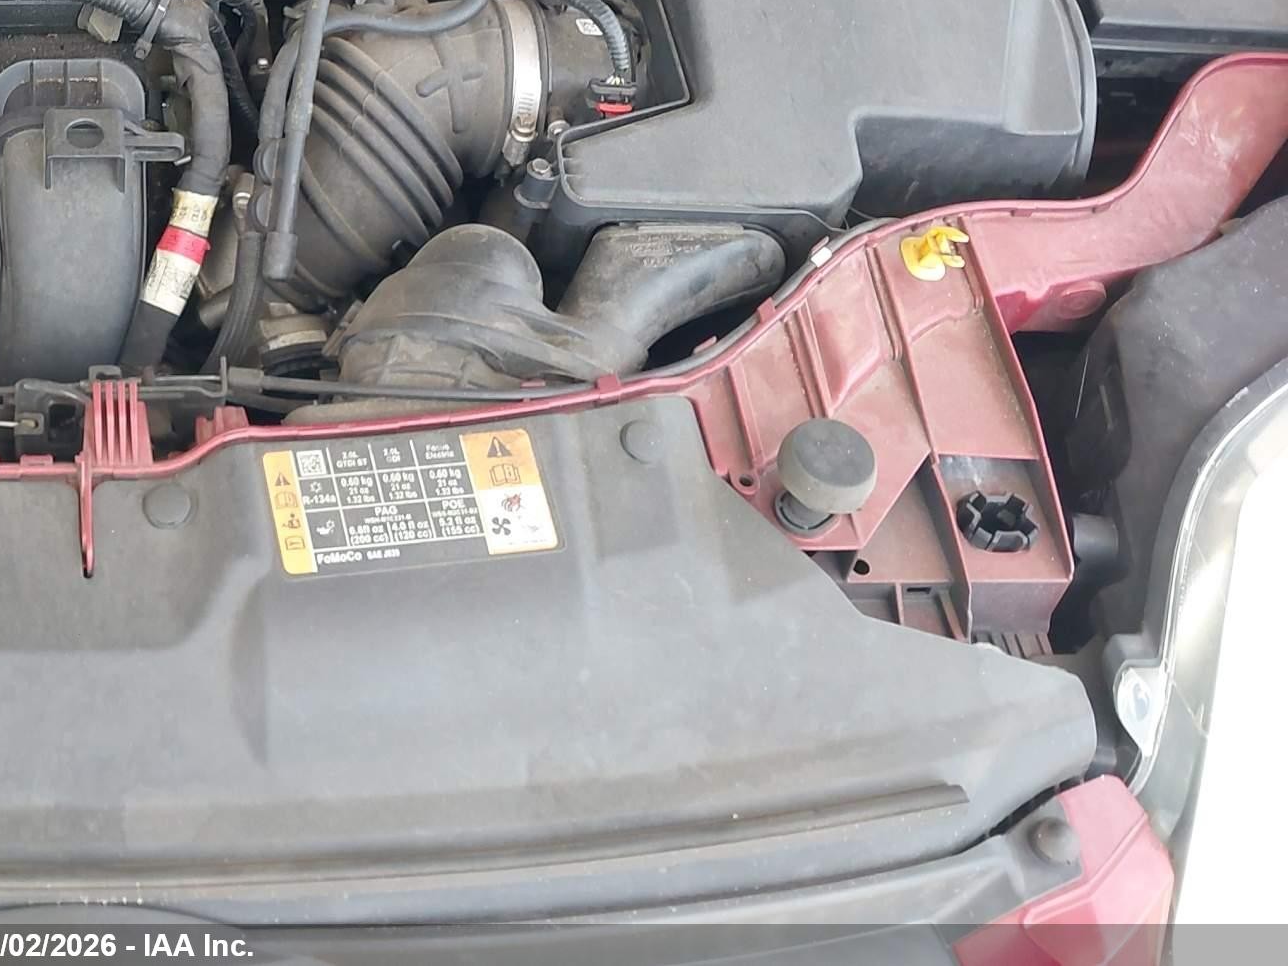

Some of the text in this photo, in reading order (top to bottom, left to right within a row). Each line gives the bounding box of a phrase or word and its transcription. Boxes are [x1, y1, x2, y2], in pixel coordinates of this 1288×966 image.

[357, 457, 367, 466] ST
[382, 472, 415, 483] 0.60 kg
[429, 467, 461, 479] 0.60 kg
[340, 475, 373, 488] 0.60 kg
[390, 483, 400, 491] 21
[437, 479, 458, 488] 21 oz
[348, 487, 358, 495] 21
[302, 494, 336, 506] R-134a
[442, 498, 465, 510] POE
[374, 505, 398, 516] PAG
[407, 520, 415, 529] fl
[417, 520, 429, 529] oz
[454, 516, 463, 525] fl
[464, 516, 476, 525] oz
[372, 525, 384, 534] oz
[394, 528, 432, 542] (120 cc)
[464, 524, 480, 536] cc)
[372, 532, 389, 544] cc)
[316, 550, 362, 564] FoMoCo
[367, 550, 383, 560] SAE
